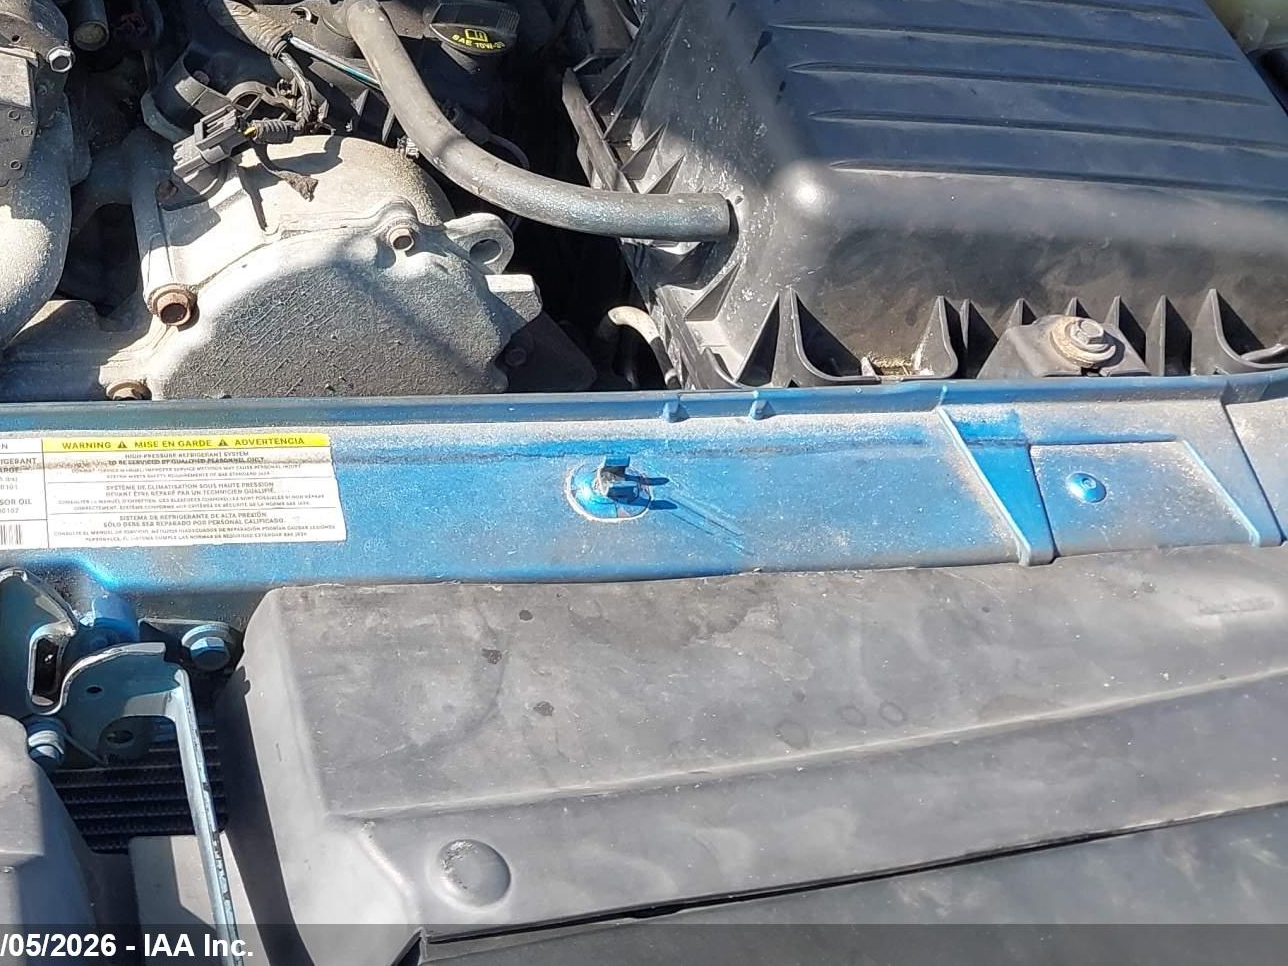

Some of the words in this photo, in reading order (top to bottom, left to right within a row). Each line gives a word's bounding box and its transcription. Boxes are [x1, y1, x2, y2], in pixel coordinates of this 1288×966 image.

[134, 440, 159, 448] MISE
[162, 440, 175, 448] EN
[177, 439, 212, 447] GARDE
[235, 437, 305, 446] ADVERTENCIA
[18, 498, 33, 506] OIL
[156, 519, 191, 527] REPARADO
[208, 518, 244, 526] PERSONAL
